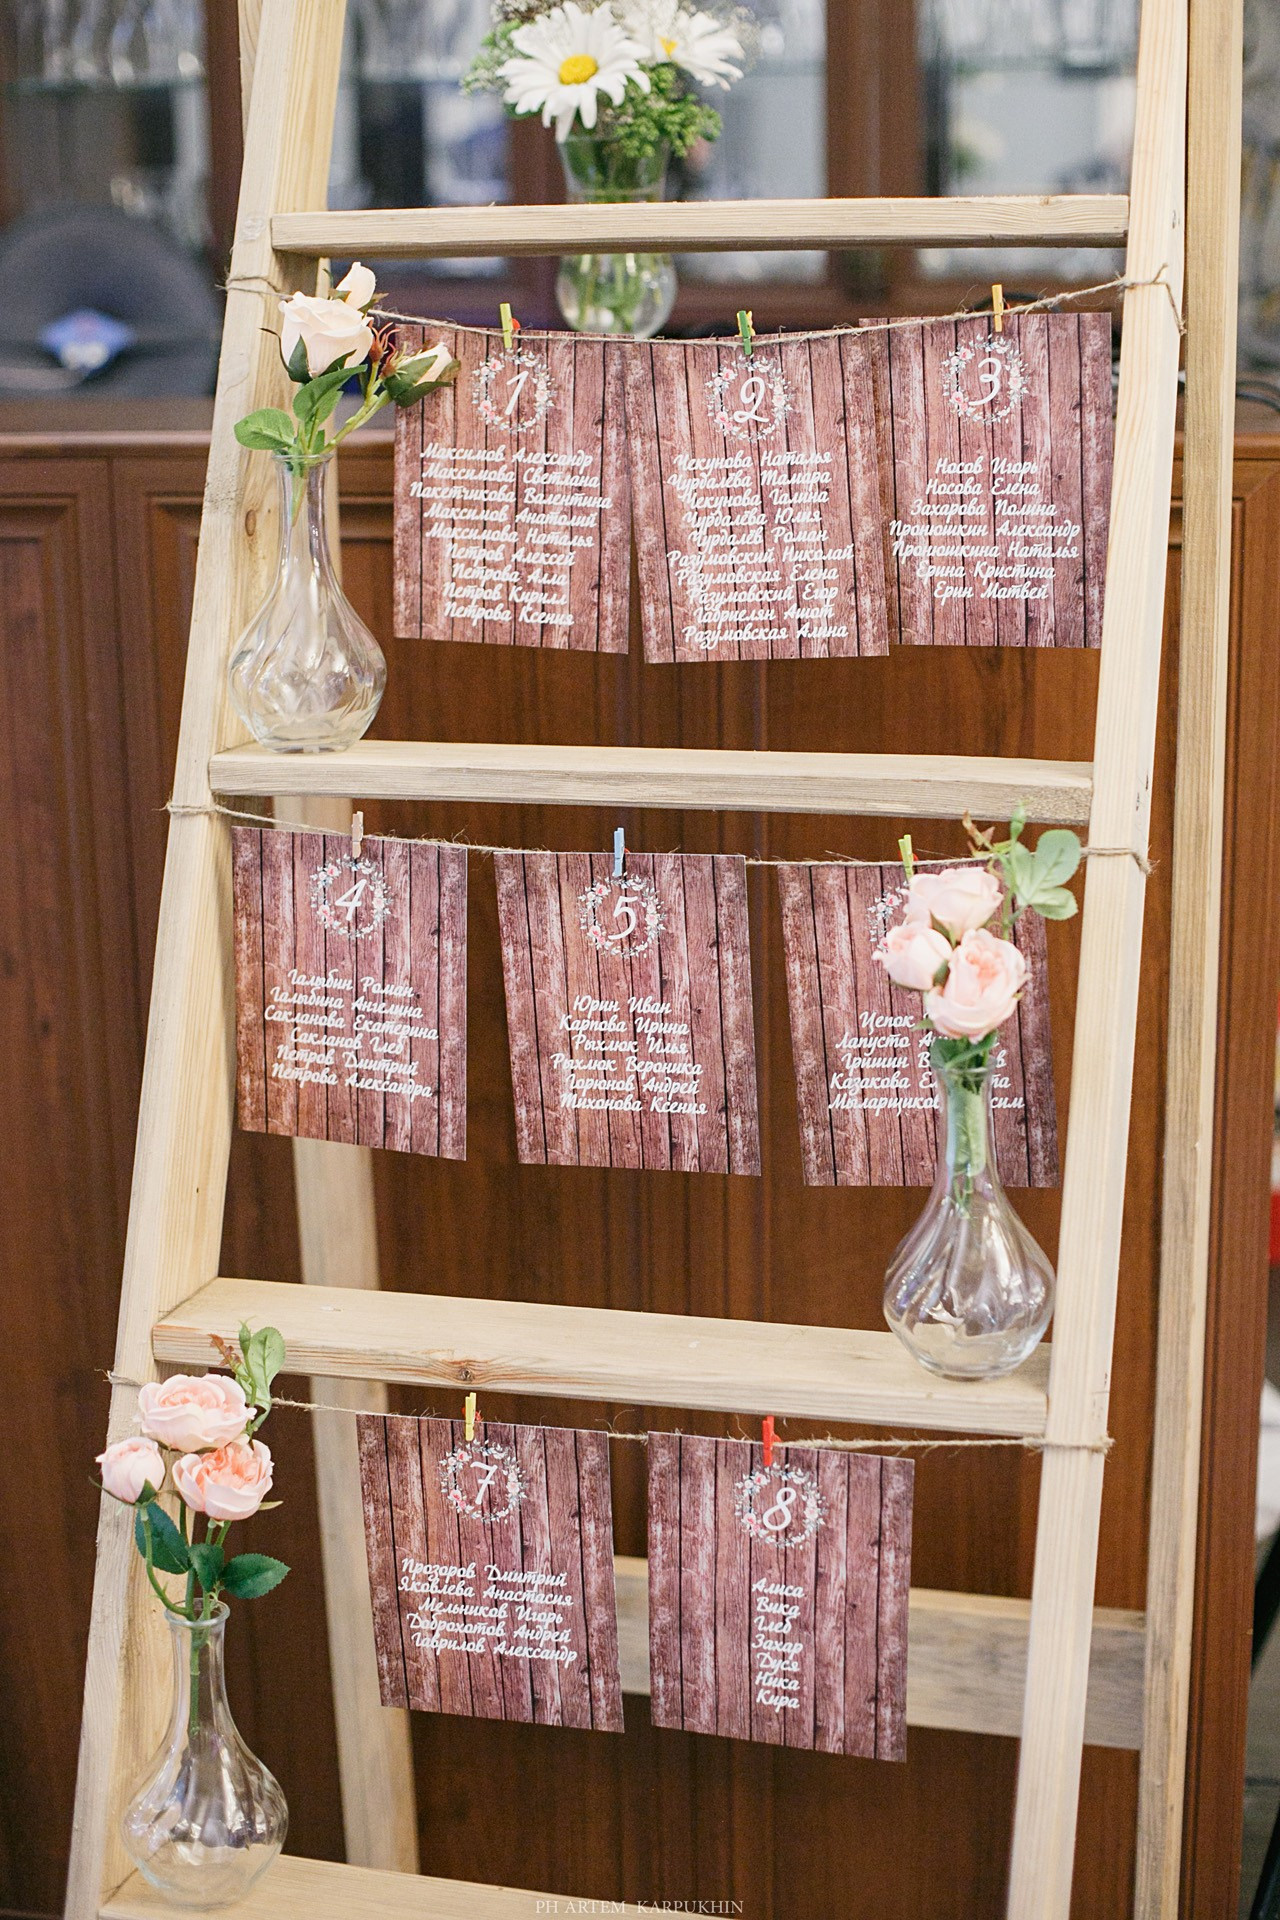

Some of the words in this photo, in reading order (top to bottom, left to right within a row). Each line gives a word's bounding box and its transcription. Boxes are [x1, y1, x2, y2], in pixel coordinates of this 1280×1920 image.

[504, 370, 529, 416] 1
[968, 357, 1001, 406] 3
[732, 375, 770, 424] 2
[420, 443, 506, 462] Максимов
[511, 448, 593, 474] Александр
[760, 450, 833, 467] Наталья
[935, 456, 984, 475] Носов
[990, 457, 1038, 481] Игорь
[422, 463, 515, 483] Максимова
[523, 467, 601, 488] Светлана
[760, 471, 832, 489] Тамара
[926, 477, 984, 496] Носова
[991, 478, 1040, 496] Елена
[410, 482, 517, 502] Пакетчикова
[524, 488, 613, 509] Валентина
[769, 489, 829, 505] Галина
[423, 503, 508, 523] Максимов
[515, 508, 597, 528] Анатолий
[774, 508, 822, 525] Юлия
[911, 498, 987, 523] Захарова
[995, 499, 1057, 517] Полина
[426, 523, 519, 543] Максимова
[526, 528, 594, 547] Наталья
[771, 527, 828, 543] Роман
[996, 520, 1080, 545] Александр
[445, 543, 505, 566] Петров
[511, 547, 576, 566] Алексей
[667, 547, 774, 572] Разумовский
[782, 543, 855, 562] Николай
[1007, 541, 1079, 559] Наталья
[452, 563, 520, 586] Петрова
[527, 568, 568, 586] Алла
[675, 566, 781, 591] Разумовская
[790, 564, 839, 581] Елена
[916, 561, 966, 585] Ерина
[974, 561, 1056, 585] Кристина
[442, 583, 502, 605] Петров
[508, 586, 568, 608] Кирилл
[686, 585, 794, 611] Разумовский
[802, 584, 839, 607] Егор
[934, 582, 973, 606] Ерин
[981, 582, 1048, 600] Матвей
[444, 602, 511, 626] Петрова
[519, 606, 574, 626] Ксения
[682, 623, 788, 650] Разумовская
[797, 623, 848, 639] Алина
[335, 879, 367, 921] 4
[608, 896, 638, 940] 5
[360, 976, 415, 997] Роман
[351, 996, 423, 1018] Ангелина
[573, 995, 620, 1017] Юрин
[627, 996, 672, 1013] Иван
[353, 1015, 439, 1040] Екатерина
[635, 1017, 689, 1040] Ирина
[370, 1037, 405, 1055] Глеб
[646, 1037, 688, 1054] Илья
[276, 1045, 335, 1068] Петров
[342, 1051, 419, 1080] Дмитрий
[625, 1056, 703, 1079] Вероника
[271, 1063, 338, 1088] Петрова
[345, 1073, 433, 1102] Александра
[566, 1074, 635, 1096] Горюнов
[643, 1077, 700, 1099] Андрей
[830, 1072, 910, 1095] Казакова
[560, 1093, 643, 1112] Тихонова
[650, 1097, 708, 1115] Ксения
[470, 1461, 498, 1505] 7
[762, 1487, 797, 1531] 8
[484, 1564, 567, 1590] Дмитрий
[752, 1578, 804, 1598] Алиса
[398, 1576, 475, 1598] Яковлева
[483, 1585, 574, 1606] Анастасия
[419, 1597, 508, 1618] Мельников
[515, 1606, 563, 1630] Игорь
[756, 1596, 800, 1616] Вика
[513, 1625, 571, 1647] Андрей
[754, 1616, 796, 1633] Глеб
[411, 1632, 486, 1655] Гаврилов
[493, 1641, 577, 1669] Александр
[751, 1634, 804, 1660] Захар
[756, 1652, 800, 1674] Дуся
[756, 1689, 800, 1713] Кира
